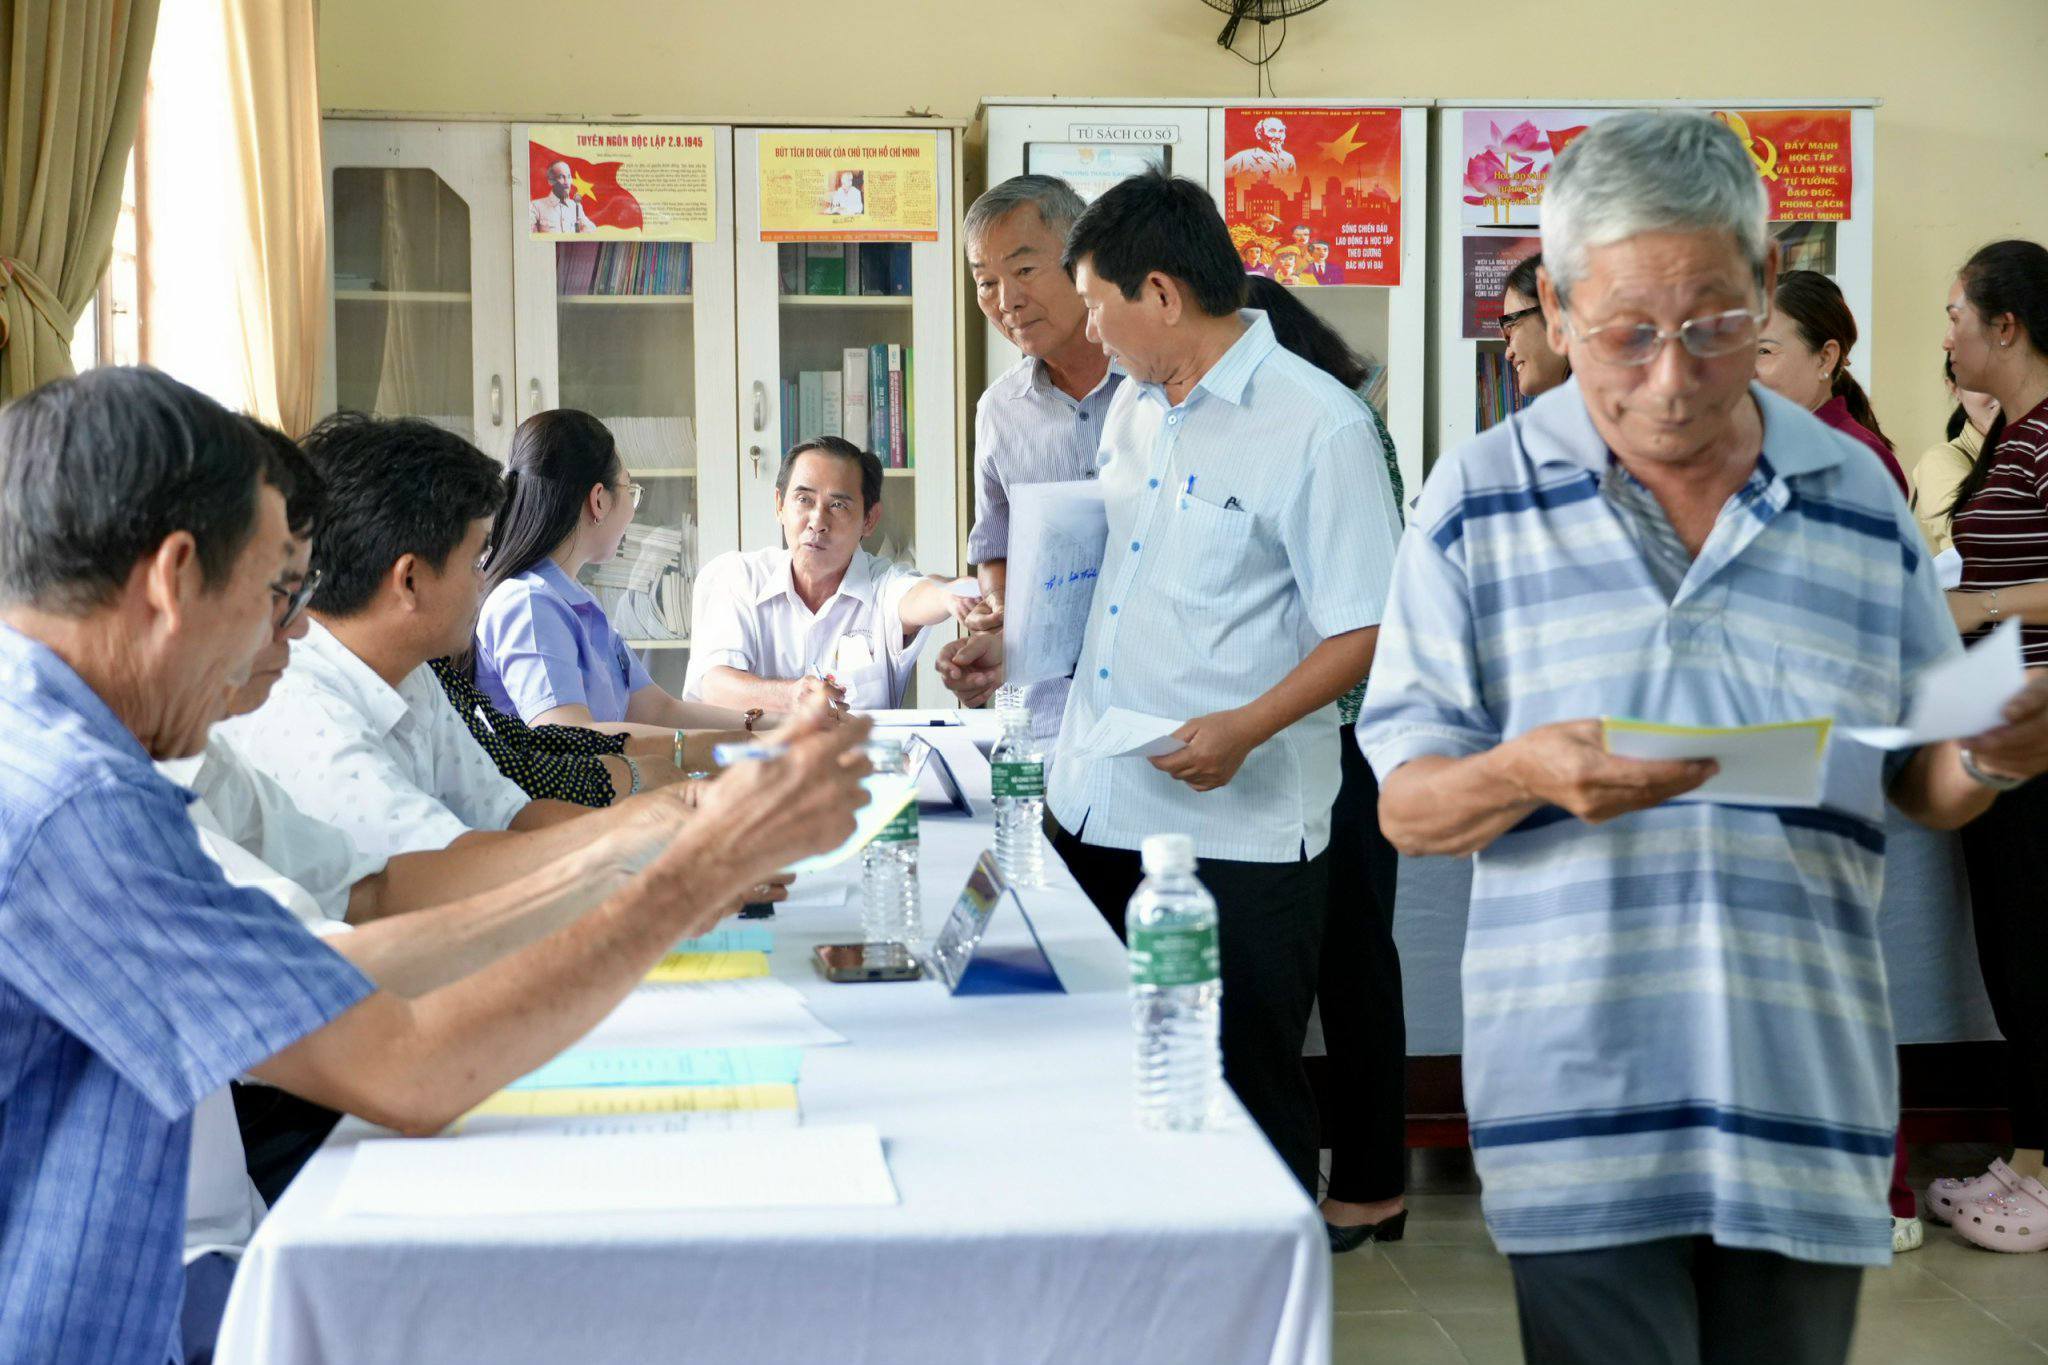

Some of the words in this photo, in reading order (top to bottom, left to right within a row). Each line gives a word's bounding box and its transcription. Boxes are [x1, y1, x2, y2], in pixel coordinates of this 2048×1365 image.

[1076, 127, 1093, 139] TỦ
[1097, 127, 1130, 139] SÁCH
[1134, 128, 1152, 140] CƠ
[1155, 127, 1171, 140] SỞ
[577, 134, 604, 147] TUYÊN
[606, 134, 628, 147] NGÔN
[632, 134, 648, 150] ĐỘC
[650, 134, 666, 150] LẬP
[668, 136, 703, 148] 2.9.1945
[1808, 142, 1838, 151] MẠNH
[775, 146, 788, 158] BÚT
[790, 146, 804, 158] TÍCH
[816, 146, 832, 158] CHÚC
[834, 146, 846, 158] CỦA
[848, 146, 860, 158] CHỦ
[862, 148, 877, 159] TỊCH
[879, 145, 888, 158] HỒ
[890, 146, 900, 158] CHÍ
[902, 148, 920, 158] MINH
[1819, 165, 1846, 174] THEO
